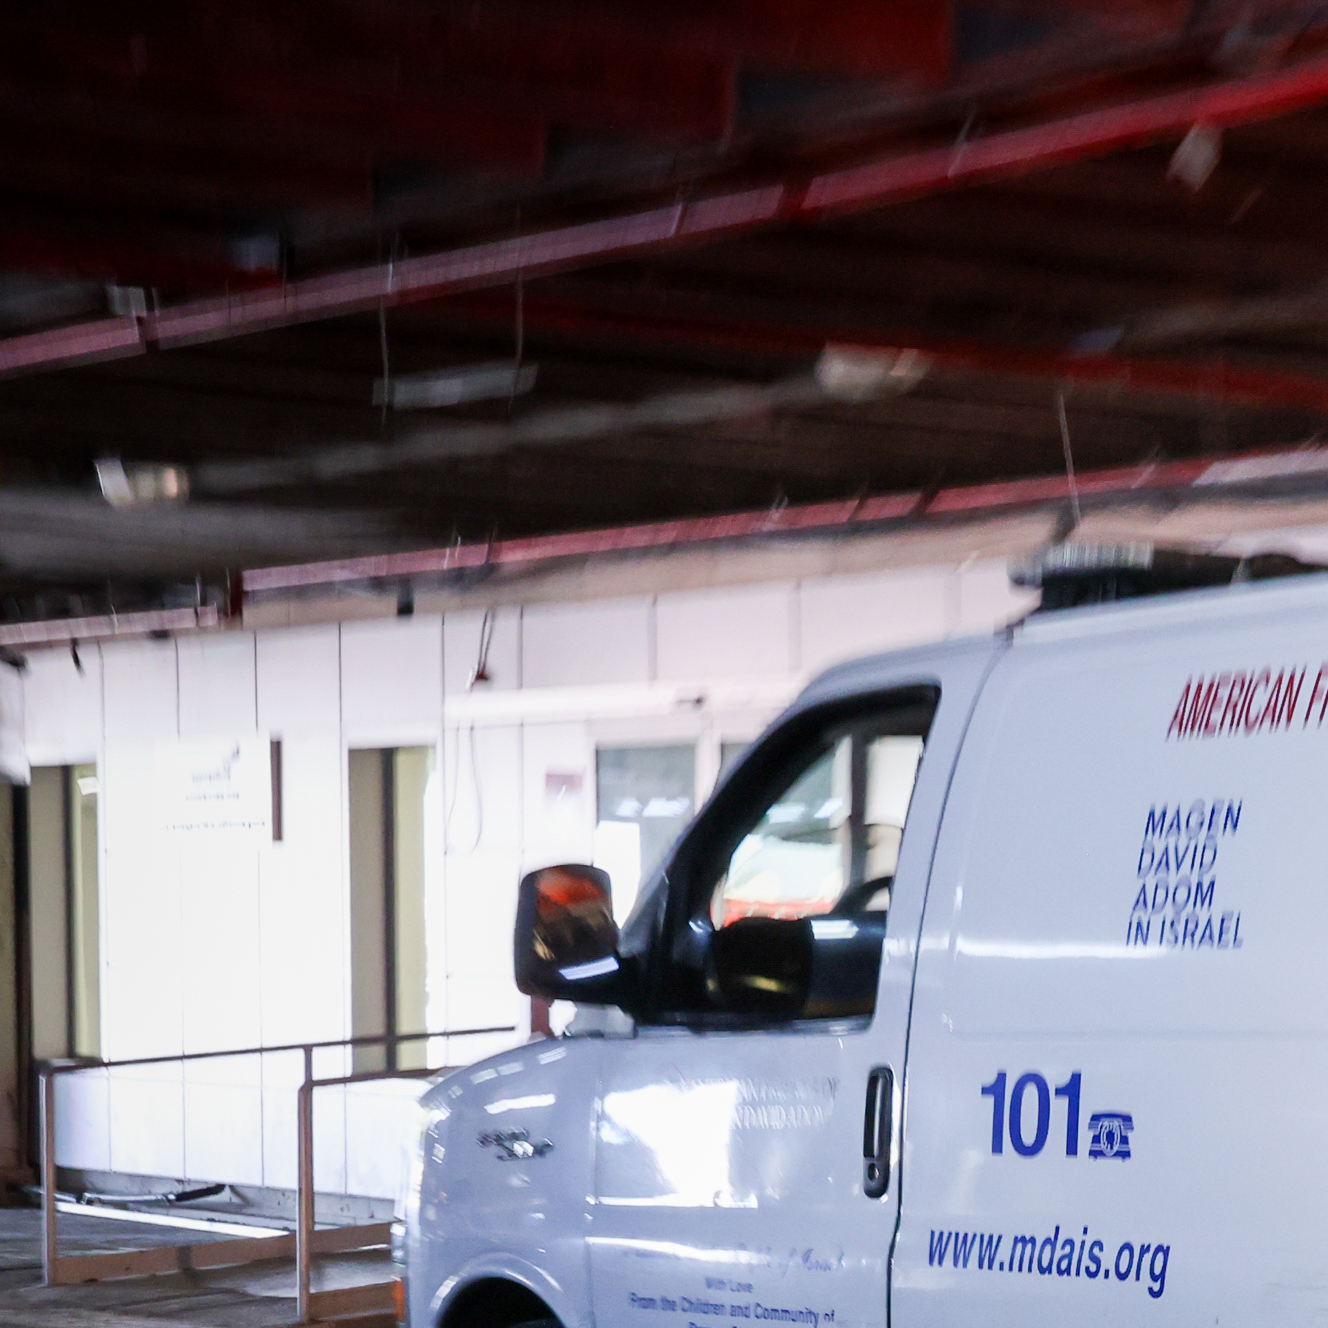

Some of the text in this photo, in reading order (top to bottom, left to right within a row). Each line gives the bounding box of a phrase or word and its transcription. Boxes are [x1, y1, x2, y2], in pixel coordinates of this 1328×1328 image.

[1166, 663, 1306, 741] AMERICAN
[1144, 798, 1242, 839] MAGEN
[1137, 838, 1218, 878] DAVID
[1131, 876, 1216, 913] ADOM
[1125, 911, 1243, 950] IN ISRAEL
[981, 1069, 1082, 1158] 101
[928, 1224, 1171, 1299] www.mdais.org
[681, 1296, 726, 1316] Children
[730, 1302, 750, 1318] and
[753, 1302, 819, 1328] Community
[824, 1309, 835, 1322] of
